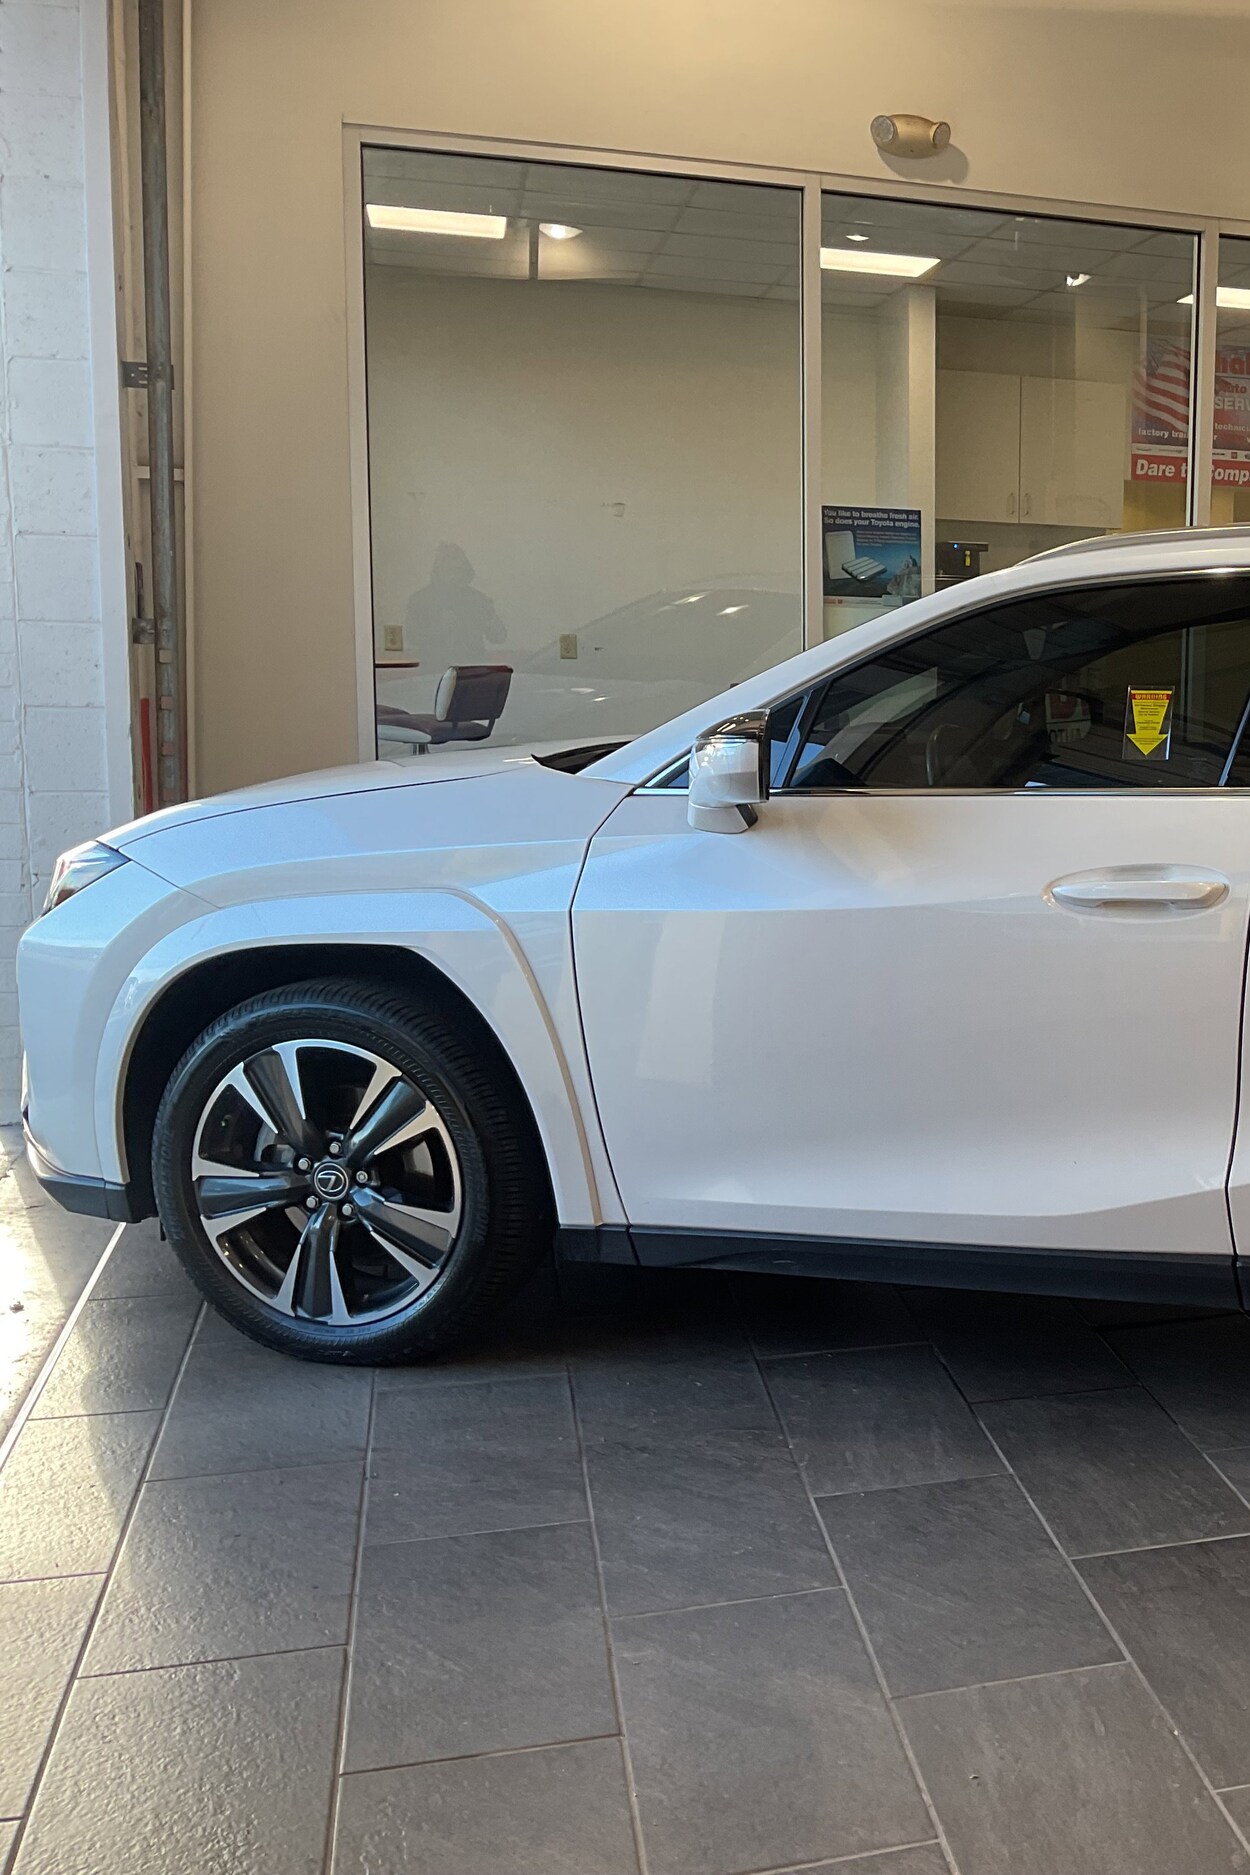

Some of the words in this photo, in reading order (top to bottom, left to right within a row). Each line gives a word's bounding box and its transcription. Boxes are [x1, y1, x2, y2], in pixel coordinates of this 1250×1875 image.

[1138, 427, 1169, 439] factory
[1172, 430, 1188, 438] trai
[1136, 459, 1175, 477] Dare
[861, 511, 888, 519] breathe
[889, 512, 907, 520] fresh
[870, 519, 894, 528] Toyota
[895, 521, 920, 529] engine.
